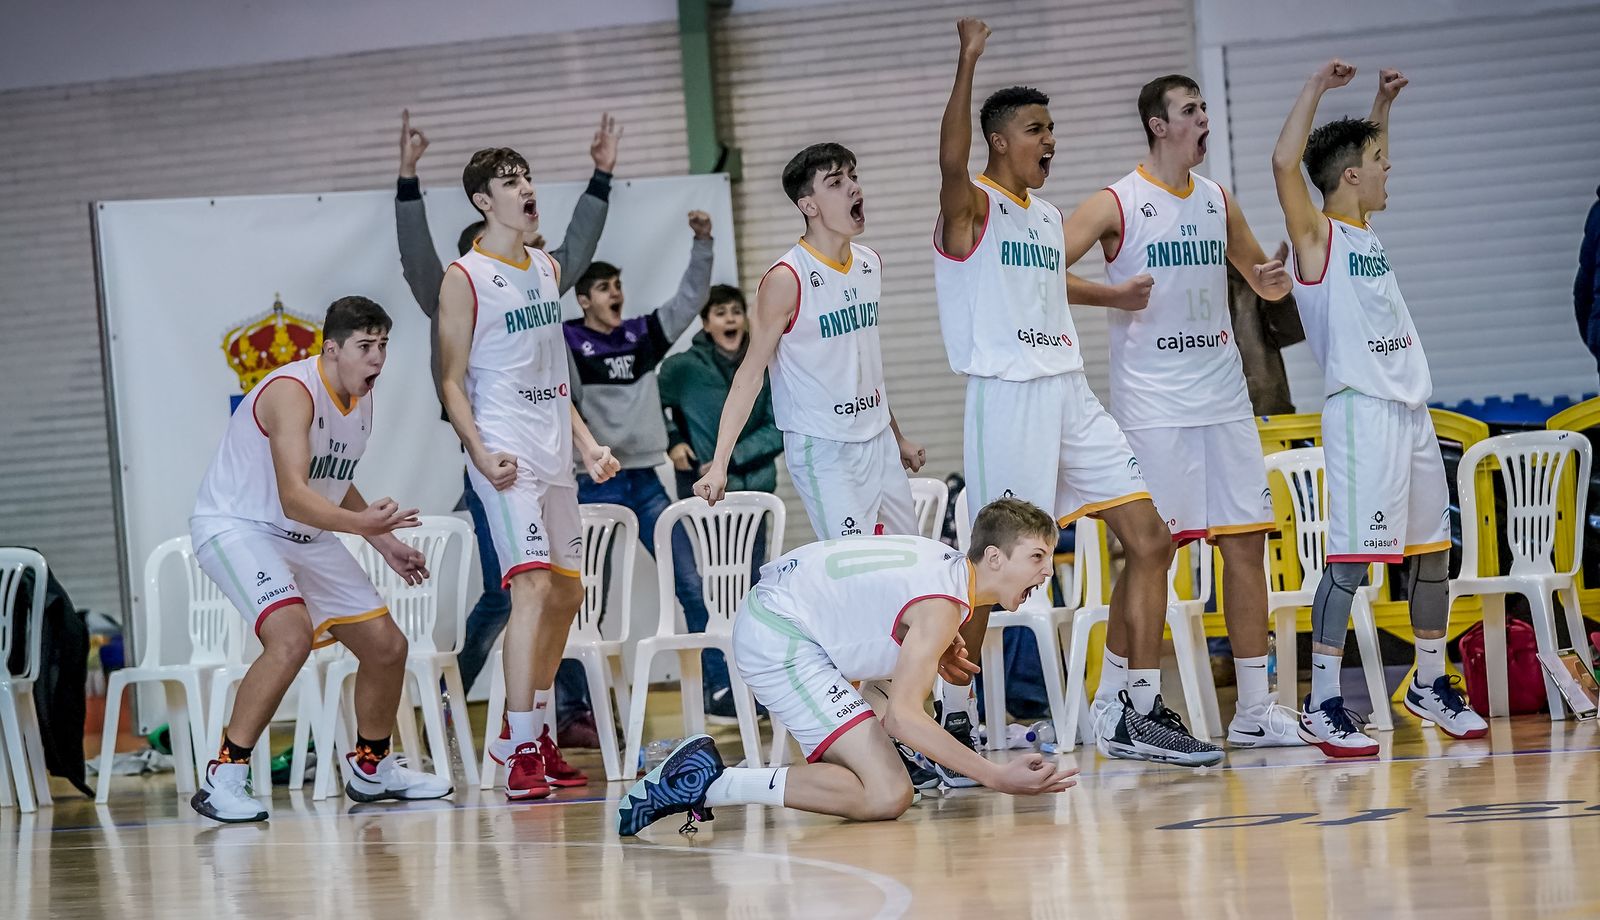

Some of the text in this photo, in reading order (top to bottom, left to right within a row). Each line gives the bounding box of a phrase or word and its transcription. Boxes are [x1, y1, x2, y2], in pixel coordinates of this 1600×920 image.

[1181, 225, 1198, 236] SOY
[1185, 288, 1212, 322] 15
[1017, 328, 1063, 348] cajasur
[1156, 331, 1221, 353] cajasur
[329, 438, 348, 454] SOY
[841, 528, 862, 536] CIPA
[256, 585, 290, 605] cajasur
[830, 689, 850, 704] CIPA
